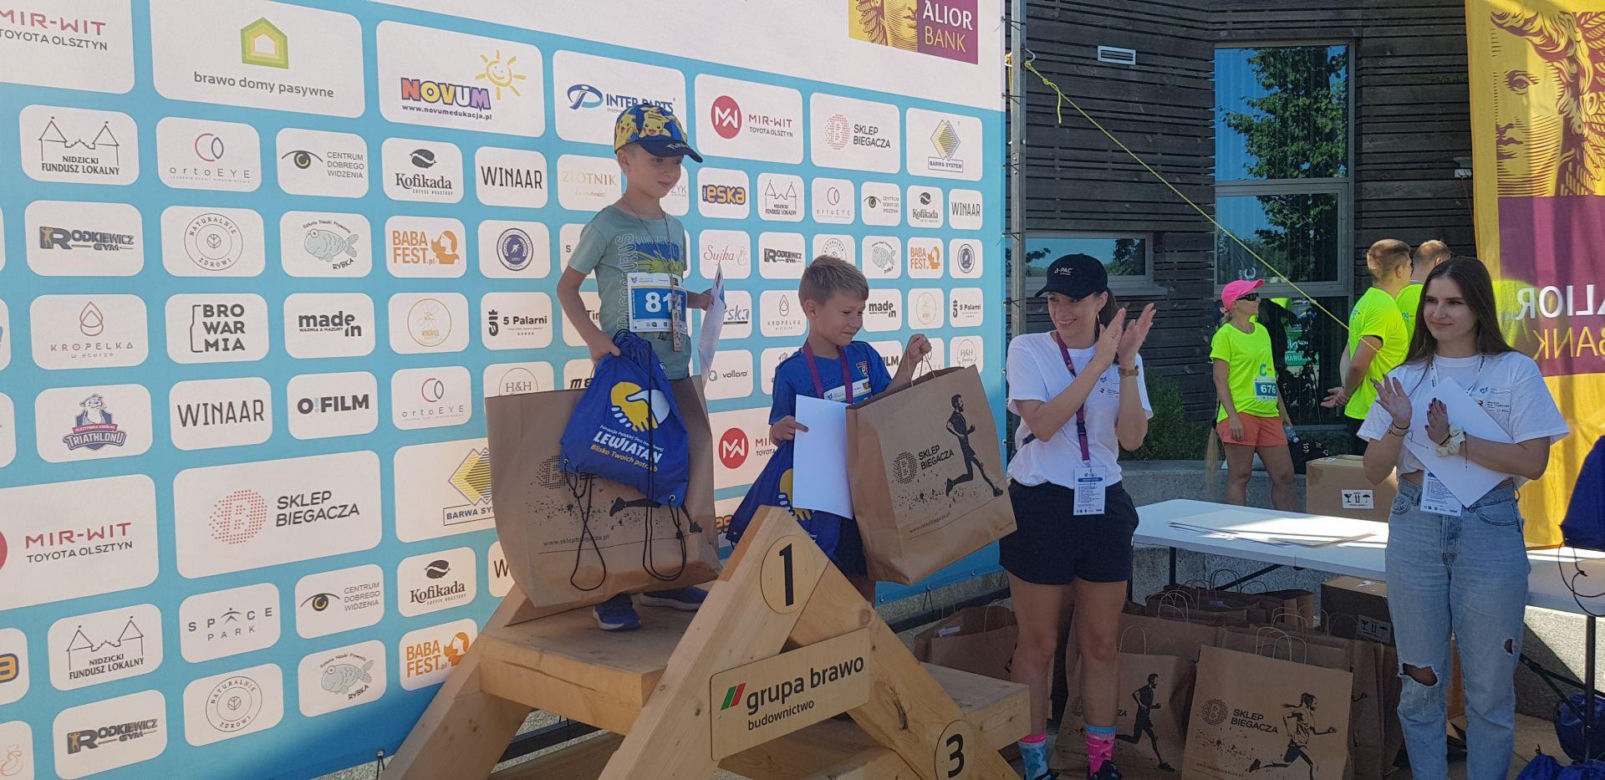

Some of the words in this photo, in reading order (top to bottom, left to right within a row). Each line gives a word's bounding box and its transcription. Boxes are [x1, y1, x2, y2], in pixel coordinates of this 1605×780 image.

[923, 0, 973, 31] ALIOR
[52, 36, 108, 51] OLSZTYN
[925, 26, 966, 52] BANK
[194, 71, 236, 87] brawo
[239, 77, 275, 94] domy
[278, 84, 334, 98] pasywne
[401, 77, 491, 112] NOVUM
[606, 93, 638, 108] INTER
[402, 105, 492, 120] www.novumedukacja.pl
[749, 114, 792, 128] MIR-WIT
[853, 124, 878, 136] SKLEP
[853, 136, 891, 149] BIEGACZA
[62, 156, 99, 164] NIDZICKI
[327, 151, 364, 161] CENTRUM
[42, 163, 79, 174] FUNDUSZ
[82, 165, 120, 176] LOKALNY
[327, 160, 365, 170] DOBREGO
[327, 170, 364, 179] WIDZENIA
[395, 173, 452, 190] Kofikada
[481, 166, 543, 190] WINAAR
[707, 184, 746, 206] eska
[912, 209, 939, 220] Kofikada
[951, 202, 981, 217] WINAAR
[189, 216, 237, 237] NATURALNIE
[39, 226, 134, 250] RODKIEWICZ
[392, 230, 428, 247] BABA
[93, 243, 121, 251] GYM
[910, 247, 926, 257] BABA
[198, 257, 233, 268] ZDROWI
[202, 304, 244, 318] BRO
[869, 300, 893, 312] made
[888, 309, 897, 318] in
[298, 310, 355, 327] made
[503, 316, 510, 326] 5
[513, 315, 548, 326] Palarni
[202, 321, 246, 335] WAR
[345, 325, 362, 337] in
[50, 342, 133, 352] KROPELKA
[204, 337, 246, 352] MIA
[882, 355, 899, 367] ILM
[505, 381, 532, 393] H&H
[1260, 384, 1277, 394] 676
[177, 399, 264, 427] WINAAR
[63, 431, 127, 450] TRIATHLONU
[593, 431, 663, 464] LEWIATAN
[612, 450, 635, 463] Twoich
[918, 444, 940, 461] SKLEP
[920, 449, 954, 470] BIEGACZA
[277, 490, 332, 510] SKLEP
[276, 503, 360, 527] BIEGACZA
[446, 509, 478, 520] BARWA
[25, 522, 131, 549] MIR-WIT
[26, 550, 77, 564] TOYOTA
[80, 541, 133, 556] OLSZTYN
[779, 543, 794, 607] 1
[344, 582, 380, 595] CENTRUM
[410, 581, 466, 604] Kofikada
[344, 590, 381, 604] DOBREGO
[344, 600, 379, 612] WIDZENIA
[207, 625, 255, 641] PARK
[406, 640, 441, 661] BABA
[89, 653, 124, 665] NIDZICKI
[69, 666, 105, 680] FUNDUSZ
[108, 657, 144, 673] LOKALNY
[746, 676, 805, 715] grupa
[810, 656, 864, 689] brawo
[748, 699, 815, 731] budownictwo
[1233, 708, 1264, 721] SKLEP
[1231, 717, 1279, 735] BIEGACZA
[67, 718, 158, 754] RODKIEWICZ
[118, 731, 144, 742] GYM
[946, 733, 965, 778] 3
